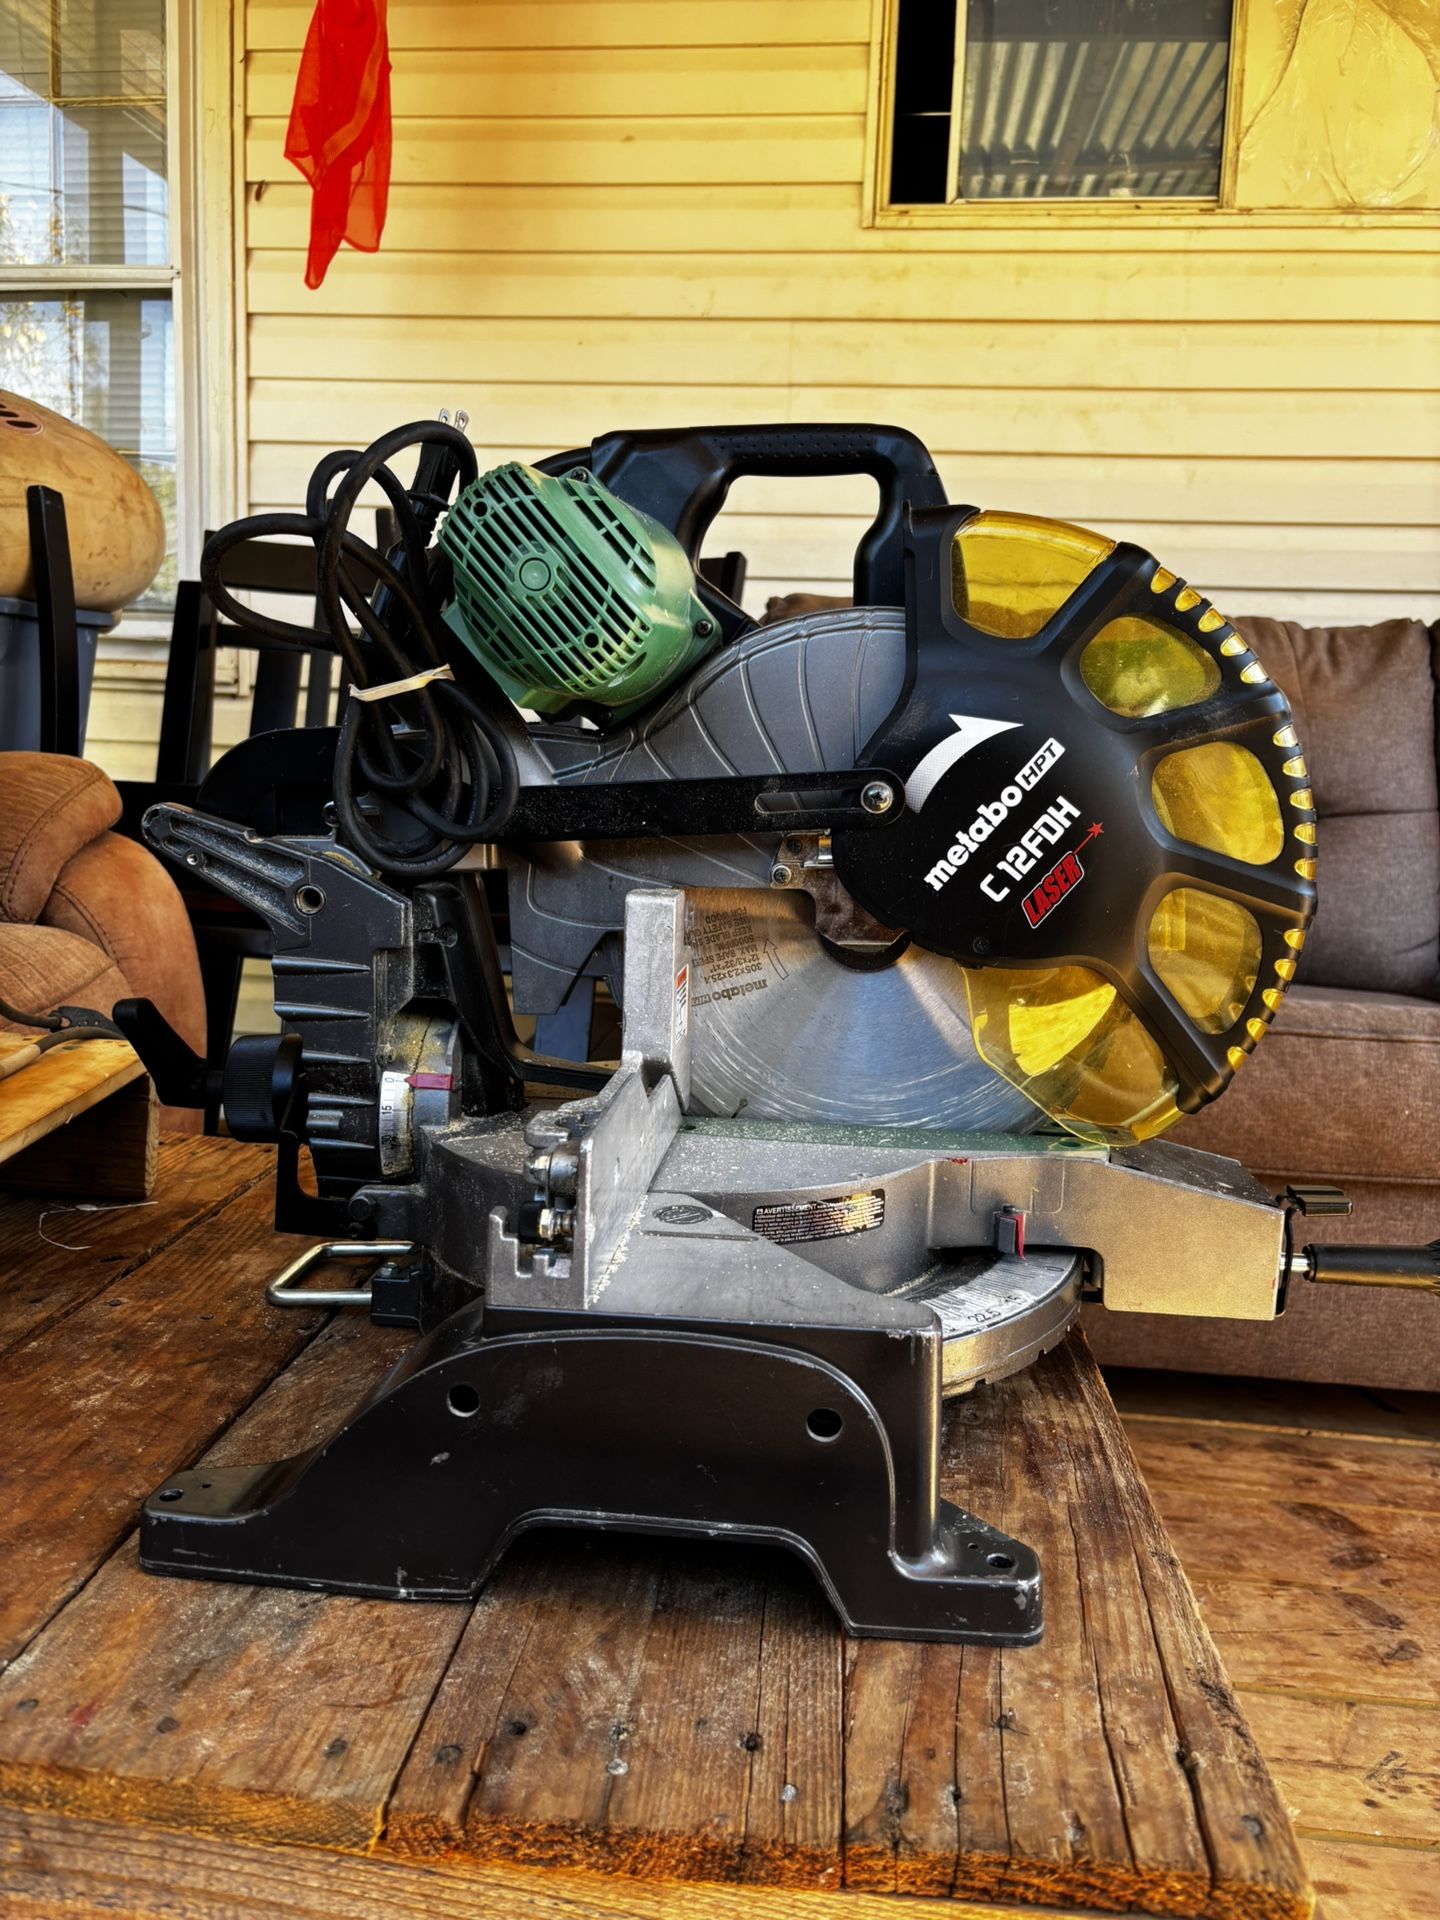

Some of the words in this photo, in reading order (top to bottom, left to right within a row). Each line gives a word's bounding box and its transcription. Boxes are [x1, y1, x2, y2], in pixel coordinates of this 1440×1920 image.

[924, 785, 1022, 892] metabo
[1018, 740, 1062, 788] HPT
[980, 873, 1010, 902] C
[996, 795, 1081, 881] 12FDH
[1022, 853, 1083, 926] LASER
[716, 949, 737, 960] SAFE
[712, 979, 768, 1000] metabo
[382, 1105, 392, 1115] 15
